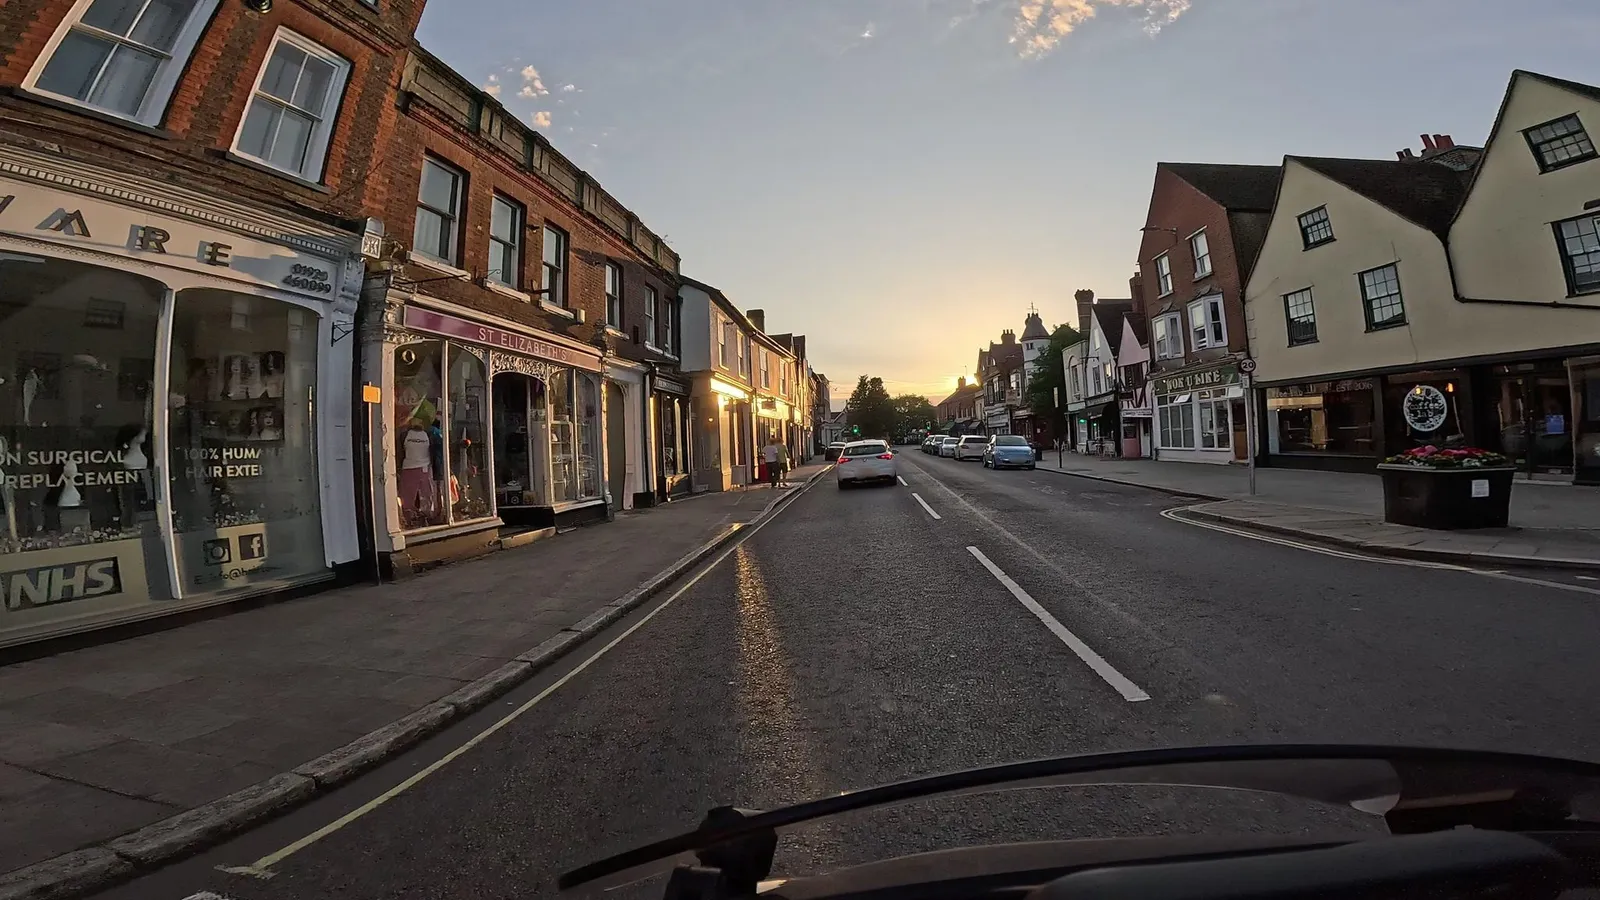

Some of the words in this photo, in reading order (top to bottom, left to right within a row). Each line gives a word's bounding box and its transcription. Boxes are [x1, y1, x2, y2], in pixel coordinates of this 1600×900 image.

[478, 326, 495, 344] ST
[1242, 361, 1254, 369] 20
[1416, 409, 1434, 418] lab
[27, 449, 124, 466] SURGICAL
[8, 560, 115, 610] NHS
